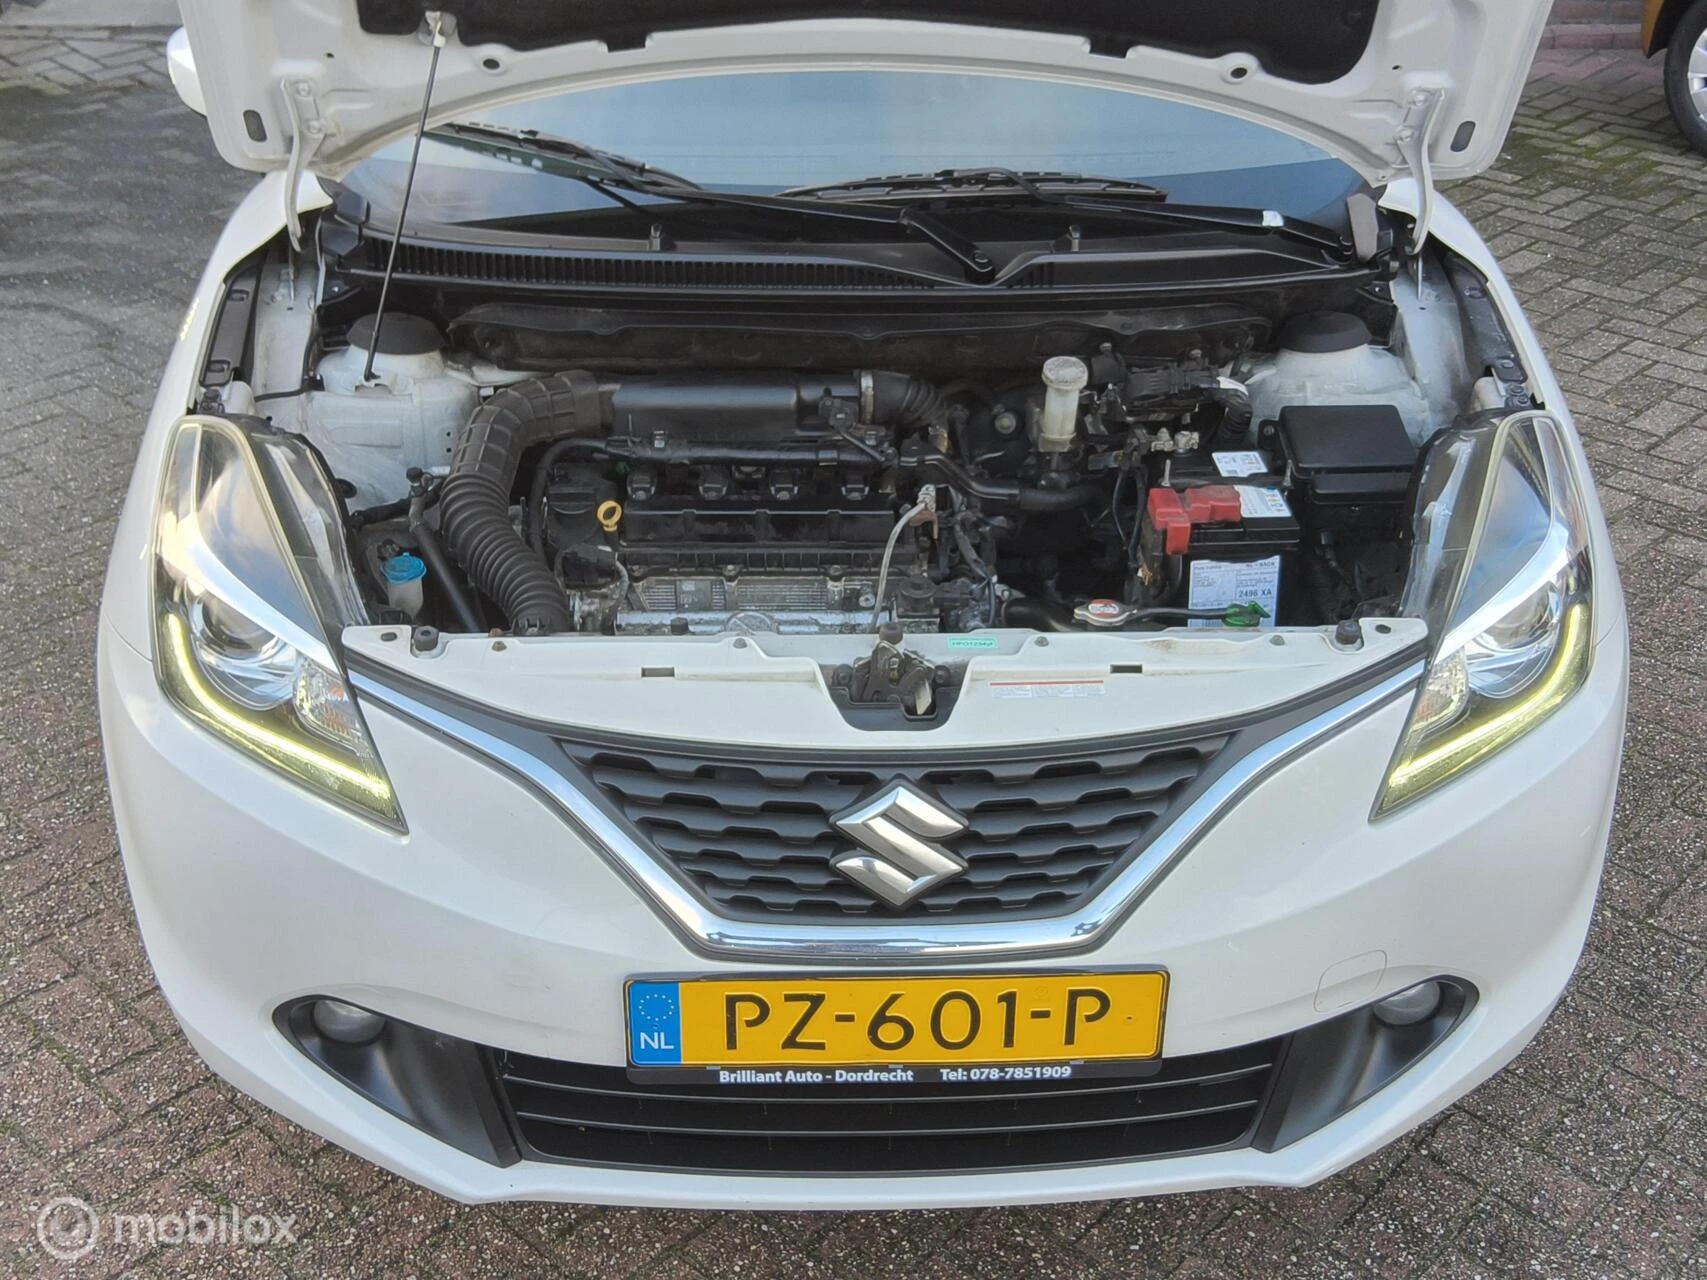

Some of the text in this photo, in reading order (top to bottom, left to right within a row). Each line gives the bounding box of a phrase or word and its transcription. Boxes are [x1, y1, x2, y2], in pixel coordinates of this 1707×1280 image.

[1261, 588, 1272, 597] XA
[725, 988, 1111, 1051] PZ-601-P
[639, 1032, 675, 1050] NL
[719, 1070, 781, 1084] Brilliant
[785, 1070, 823, 1083] Auto
[835, 1069, 914, 1083] Dordrecht
[940, 1066, 1072, 1081] Tel: 078-7851909
